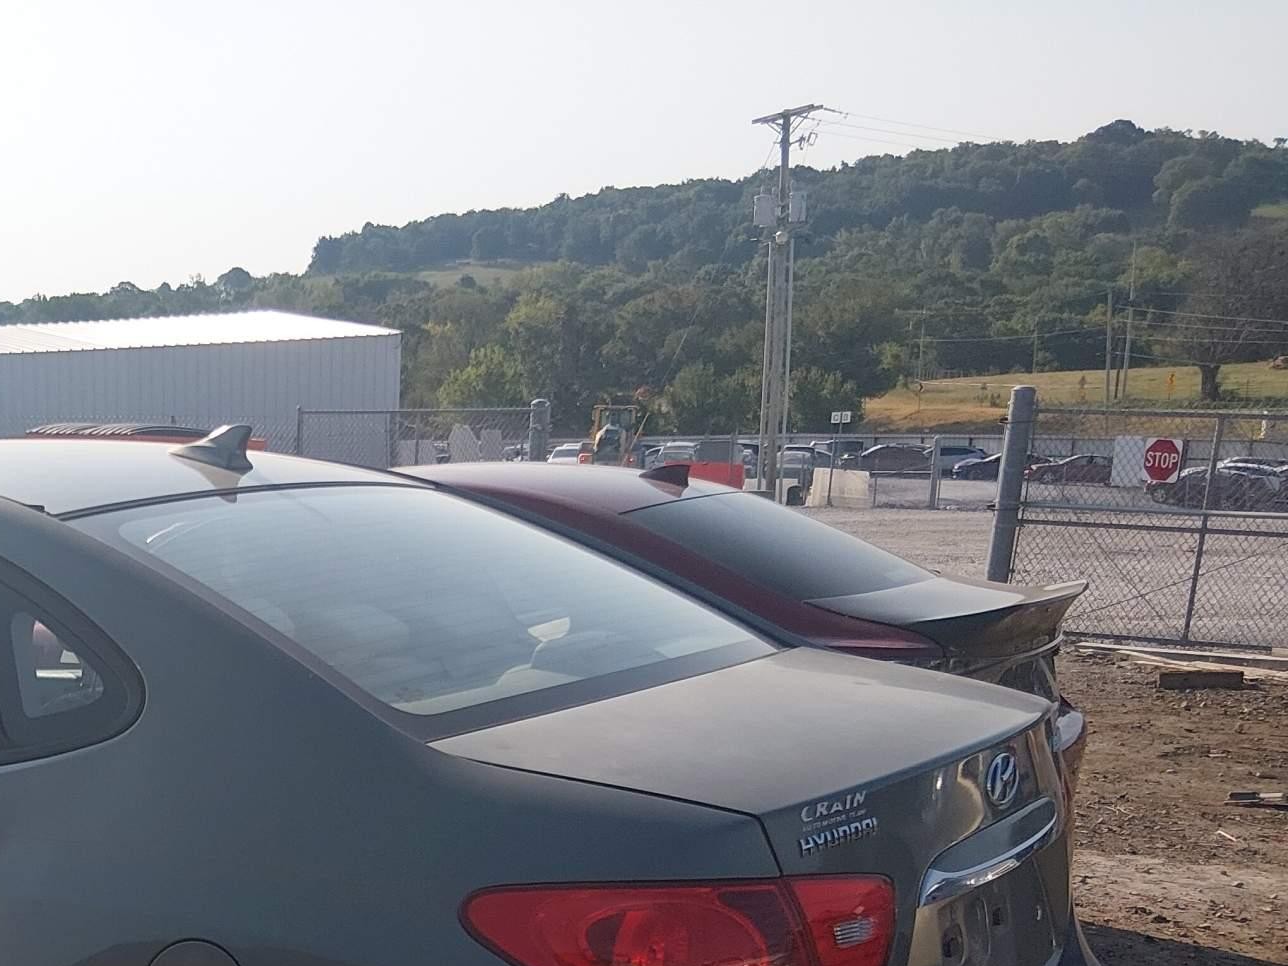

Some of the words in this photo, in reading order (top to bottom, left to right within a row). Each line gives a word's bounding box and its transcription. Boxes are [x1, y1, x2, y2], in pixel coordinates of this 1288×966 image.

[1145, 451, 1179, 469] STOP
[800, 790, 868, 822] CRAIN
[799, 816, 879, 857] HYUNDAI
